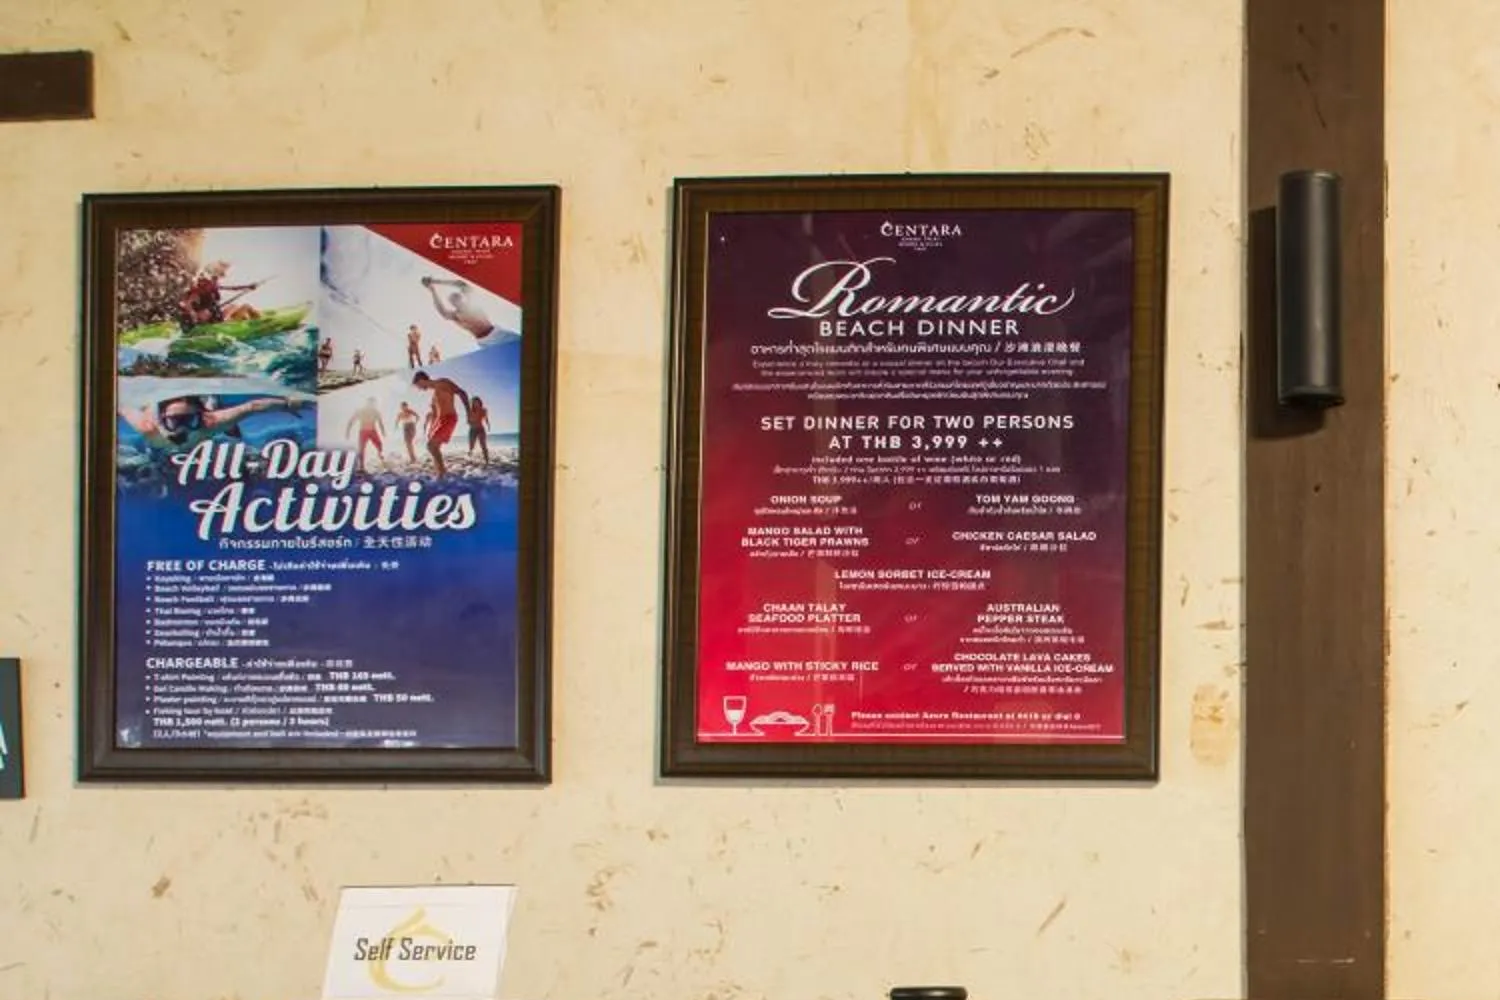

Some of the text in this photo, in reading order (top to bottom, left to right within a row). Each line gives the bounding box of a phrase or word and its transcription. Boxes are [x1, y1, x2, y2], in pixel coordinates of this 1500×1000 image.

[880, 220, 962, 236] CENTARA
[428, 232, 513, 249] CENTARA
[767, 257, 1075, 320] Romantic
[819, 318, 1020, 337] BEACH DINNER
[760, 415, 1075, 430] SET DINNER FOR TWO PERSONS
[829, 436, 853, 449] AT
[861, 436, 902, 449] THB
[911, 436, 968, 452] 3,999
[171, 439, 359, 489] All-Day
[769, 495, 843, 504] ONION SOUP
[975, 494, 1075, 504] TOM YAM GOONG
[190, 482, 477, 541] Activities
[747, 526, 863, 535] MANGO SALAD WITH
[952, 531, 1097, 541] CHICKEN CAESAR SALAD
[741, 537, 869, 547] BLACK TIGER PRAWNS
[146, 559, 182, 571] FREE
[185, 559, 205, 571] OF
[208, 559, 266, 571] CHARGE
[834, 569, 991, 579] LEMON SORBET ICE-CREAM
[763, 603, 847, 612] CHAAN TALAY
[986, 603, 1060, 613] AUSTRALIAN
[748, 613, 861, 623] SEAFOOD PLATTER
[977, 614, 1065, 623] PEPPER STEAK
[953, 653, 1091, 662] CHOCOLATE LAVA CAKES
[145, 658, 239, 669] CHARGEABLE
[725, 661, 880, 671] MANGO WITH STICKY RICE
[931, 663, 1114, 673] SERVED WITH VANILLA ICE-CREAM
[153, 717, 175, 726] THB
[353, 937, 477, 961] Self Service
